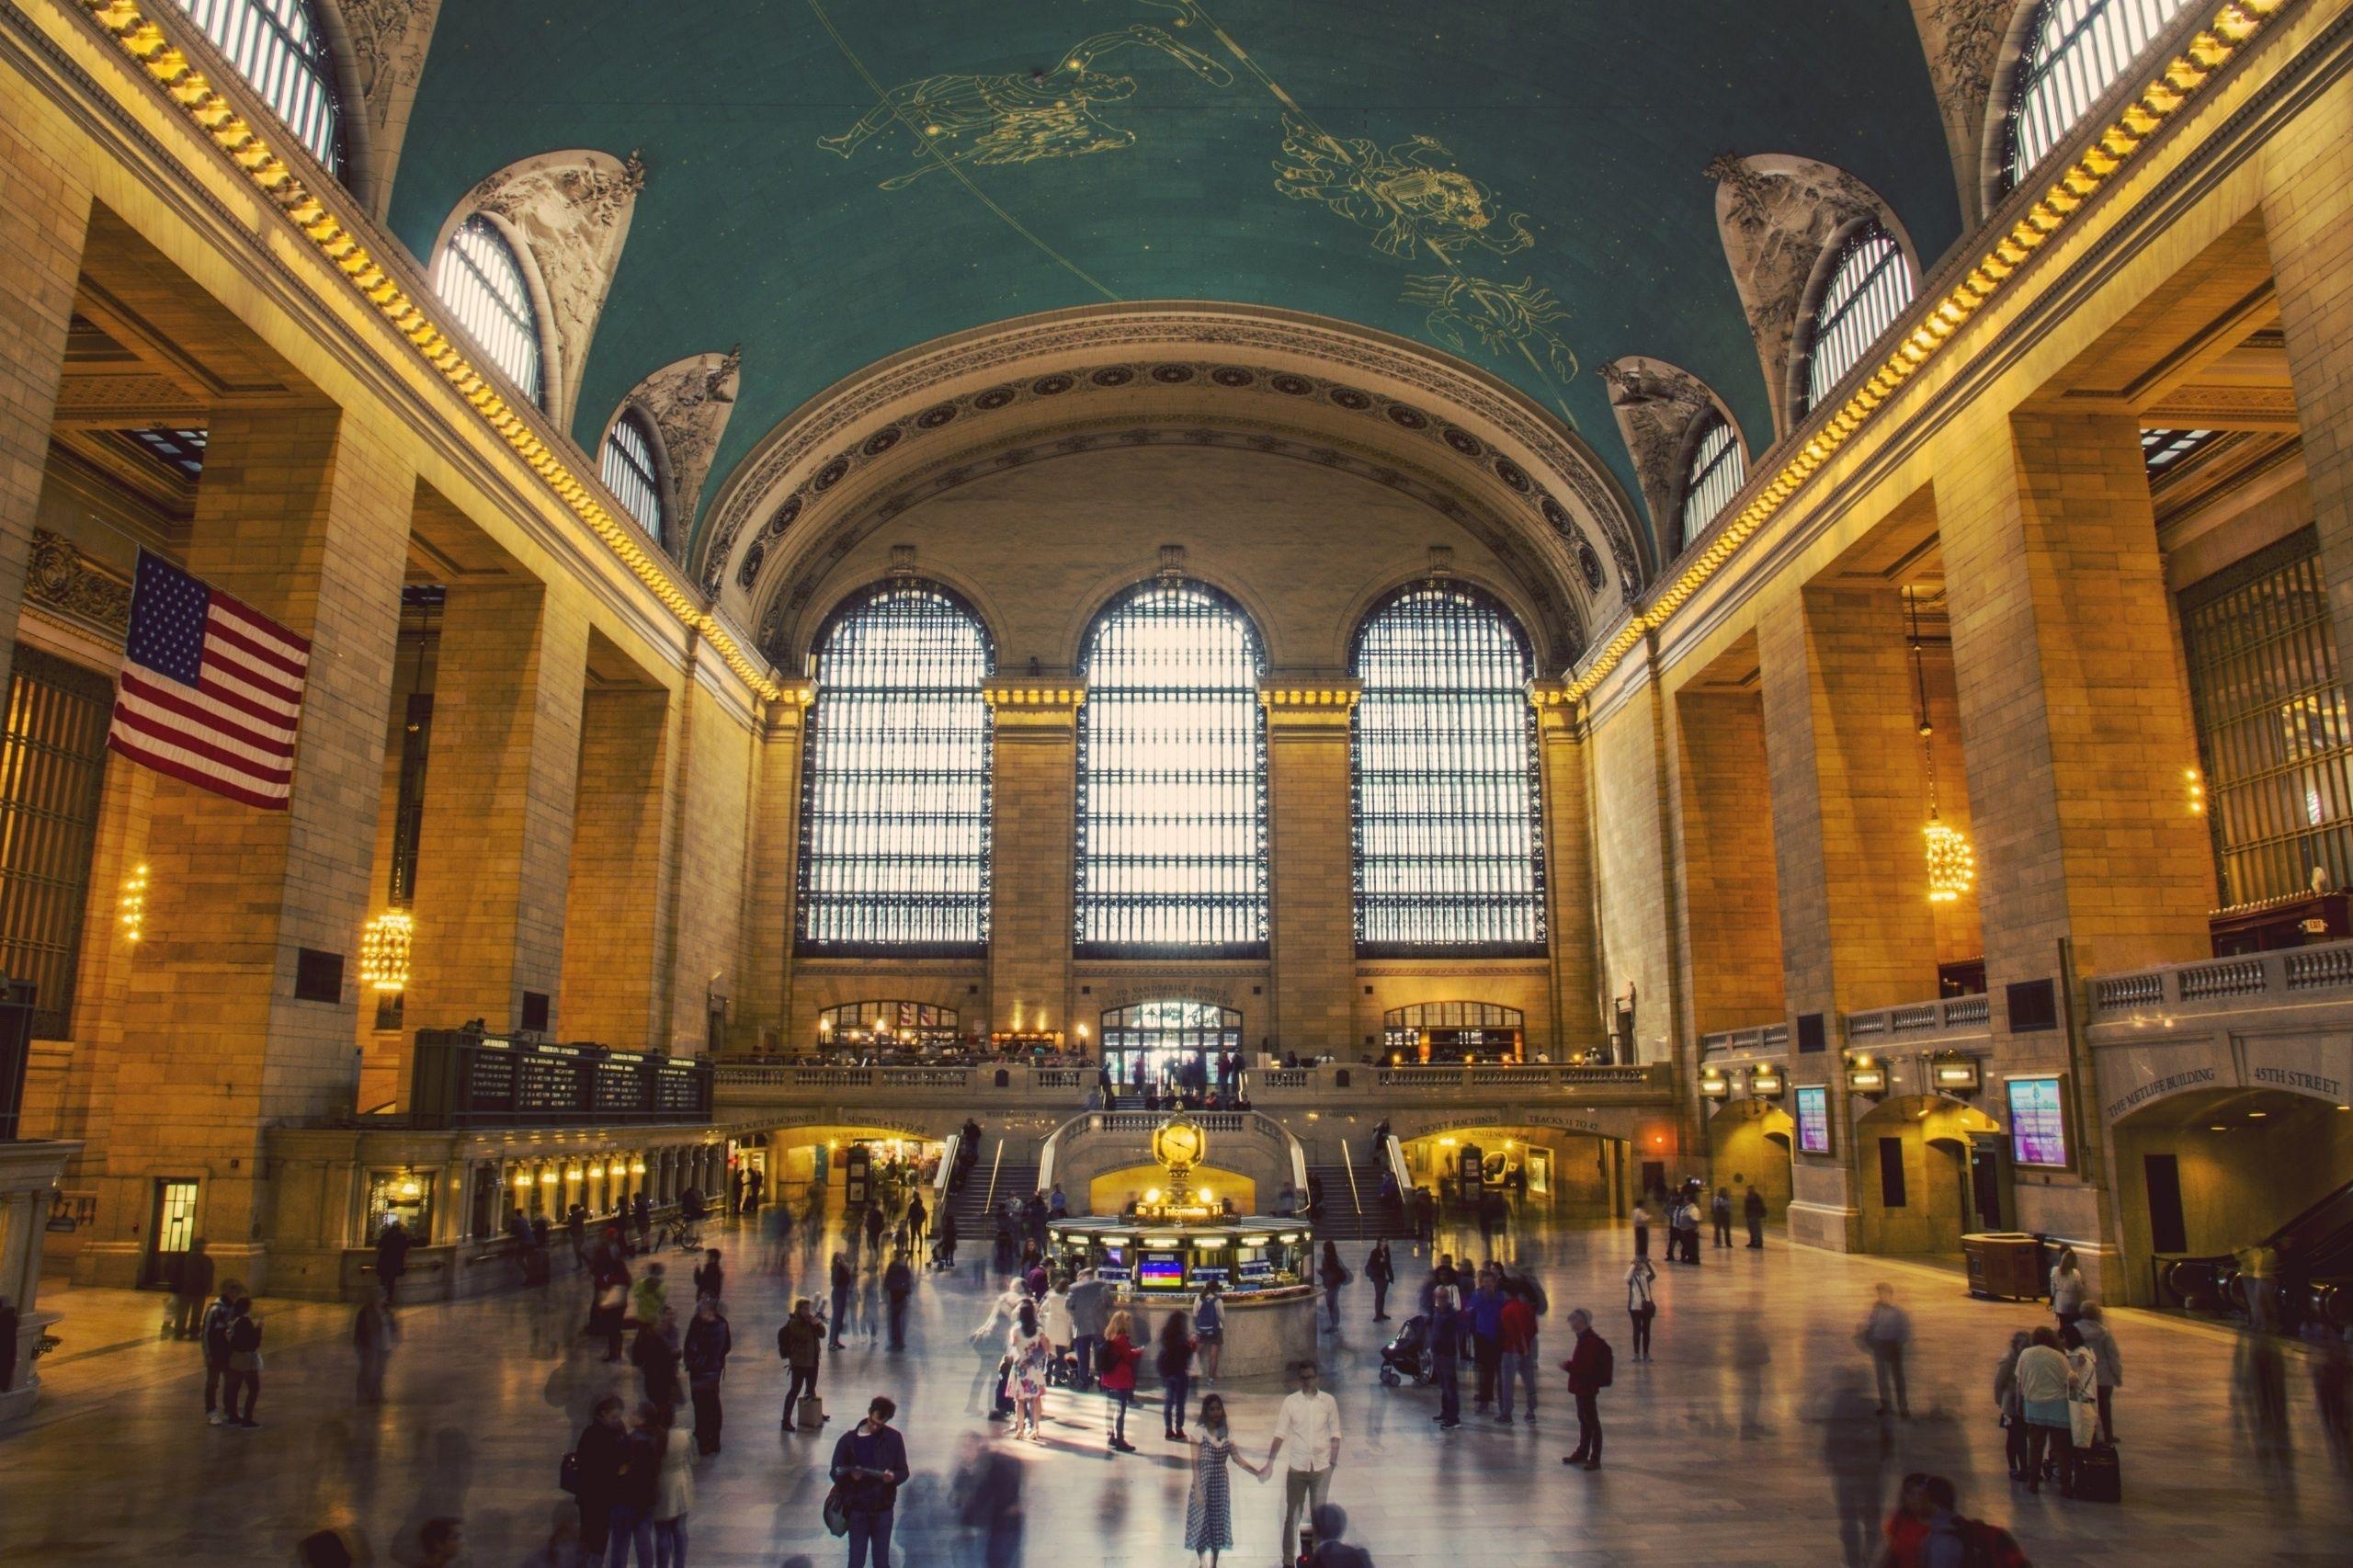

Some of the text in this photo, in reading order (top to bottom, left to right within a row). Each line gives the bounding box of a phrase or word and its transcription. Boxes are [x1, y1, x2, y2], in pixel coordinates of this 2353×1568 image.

[2310, 920, 2321, 928] EXIT
[1132, 984, 1187, 994] VANDERBILT
[1194, 985, 1228, 996] AVENUE
[2254, 1067, 2340, 1096] 45TH STREET
[2108, 1067, 2215, 1118] THE METLIFE BUILDING
[731, 1115, 817, 1132] TICKET MACHINES
[847, 1116, 881, 1126] SUBWAY
[1417, 1116, 1499, 1134] TICKET MACHINES
[1529, 1115, 1563, 1125] TRACKS
[1574, 1119, 1588, 1129] TO
[1471, 1130, 1502, 1139] WAITING
[1165, 1206, 1208, 1217] Information
